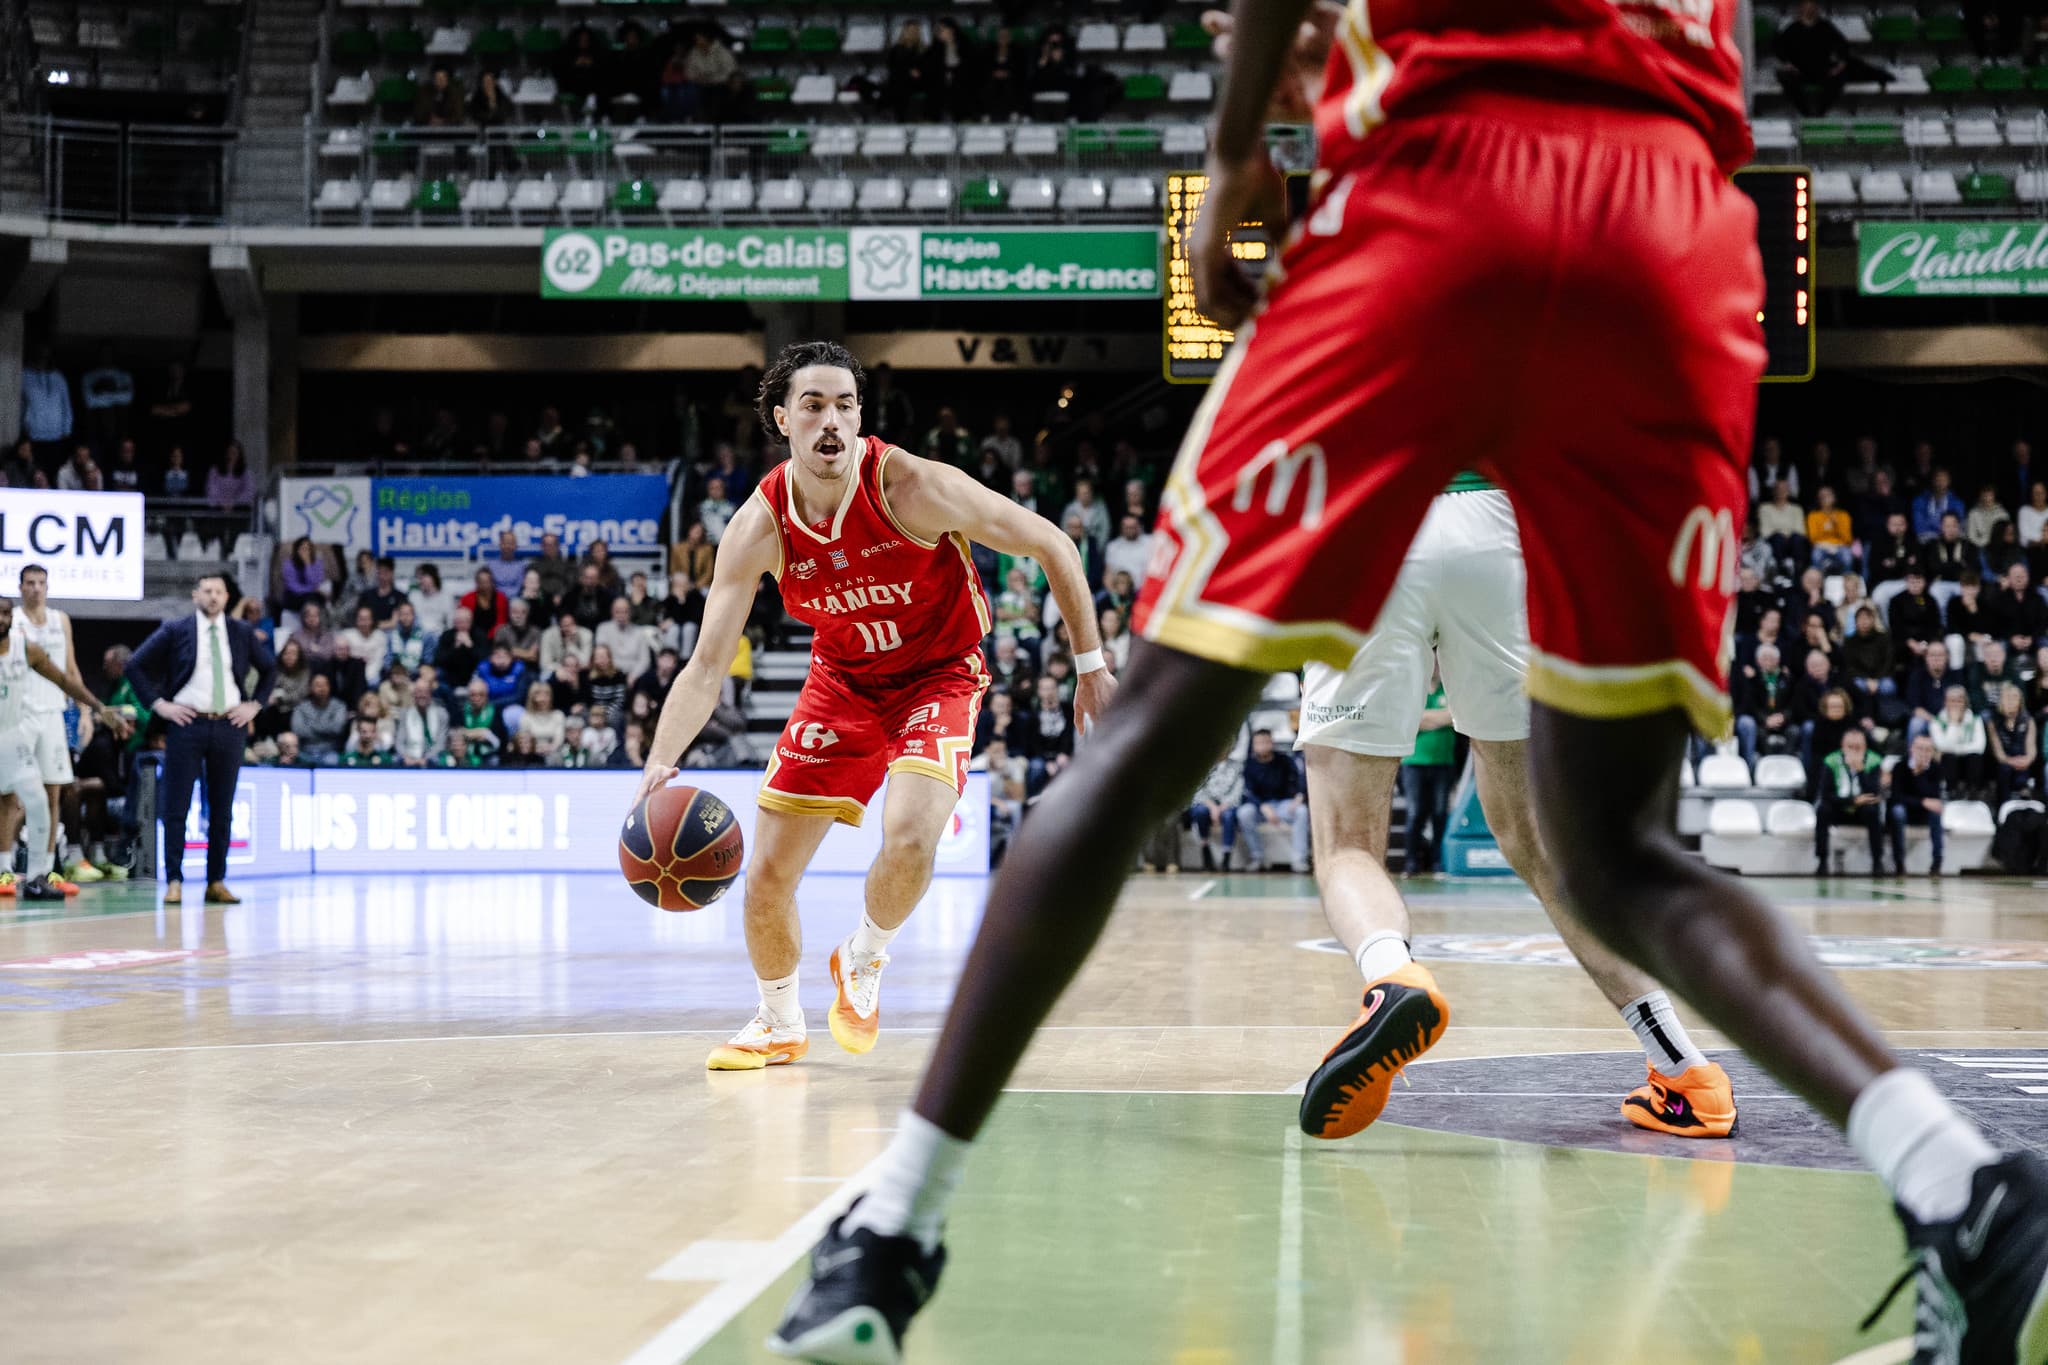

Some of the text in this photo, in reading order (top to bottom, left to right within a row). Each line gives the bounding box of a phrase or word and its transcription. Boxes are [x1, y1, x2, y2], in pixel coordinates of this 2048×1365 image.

[554, 247, 593, 275] 62
[922, 237, 1000, 263] Région
[679, 272, 820, 298] Département
[923, 263, 1157, 290] Hauts-de-France
[378, 486, 471, 515] Région
[0, 512, 125, 556] LCM
[378, 514, 658, 547] Hauts-de-France
[824, 575, 876, 593] GRAND
[851, 620, 903, 653] 10
[367, 793, 417, 851] DE
[426, 793, 544, 851] LOUER
[553, 793, 570, 851] !
